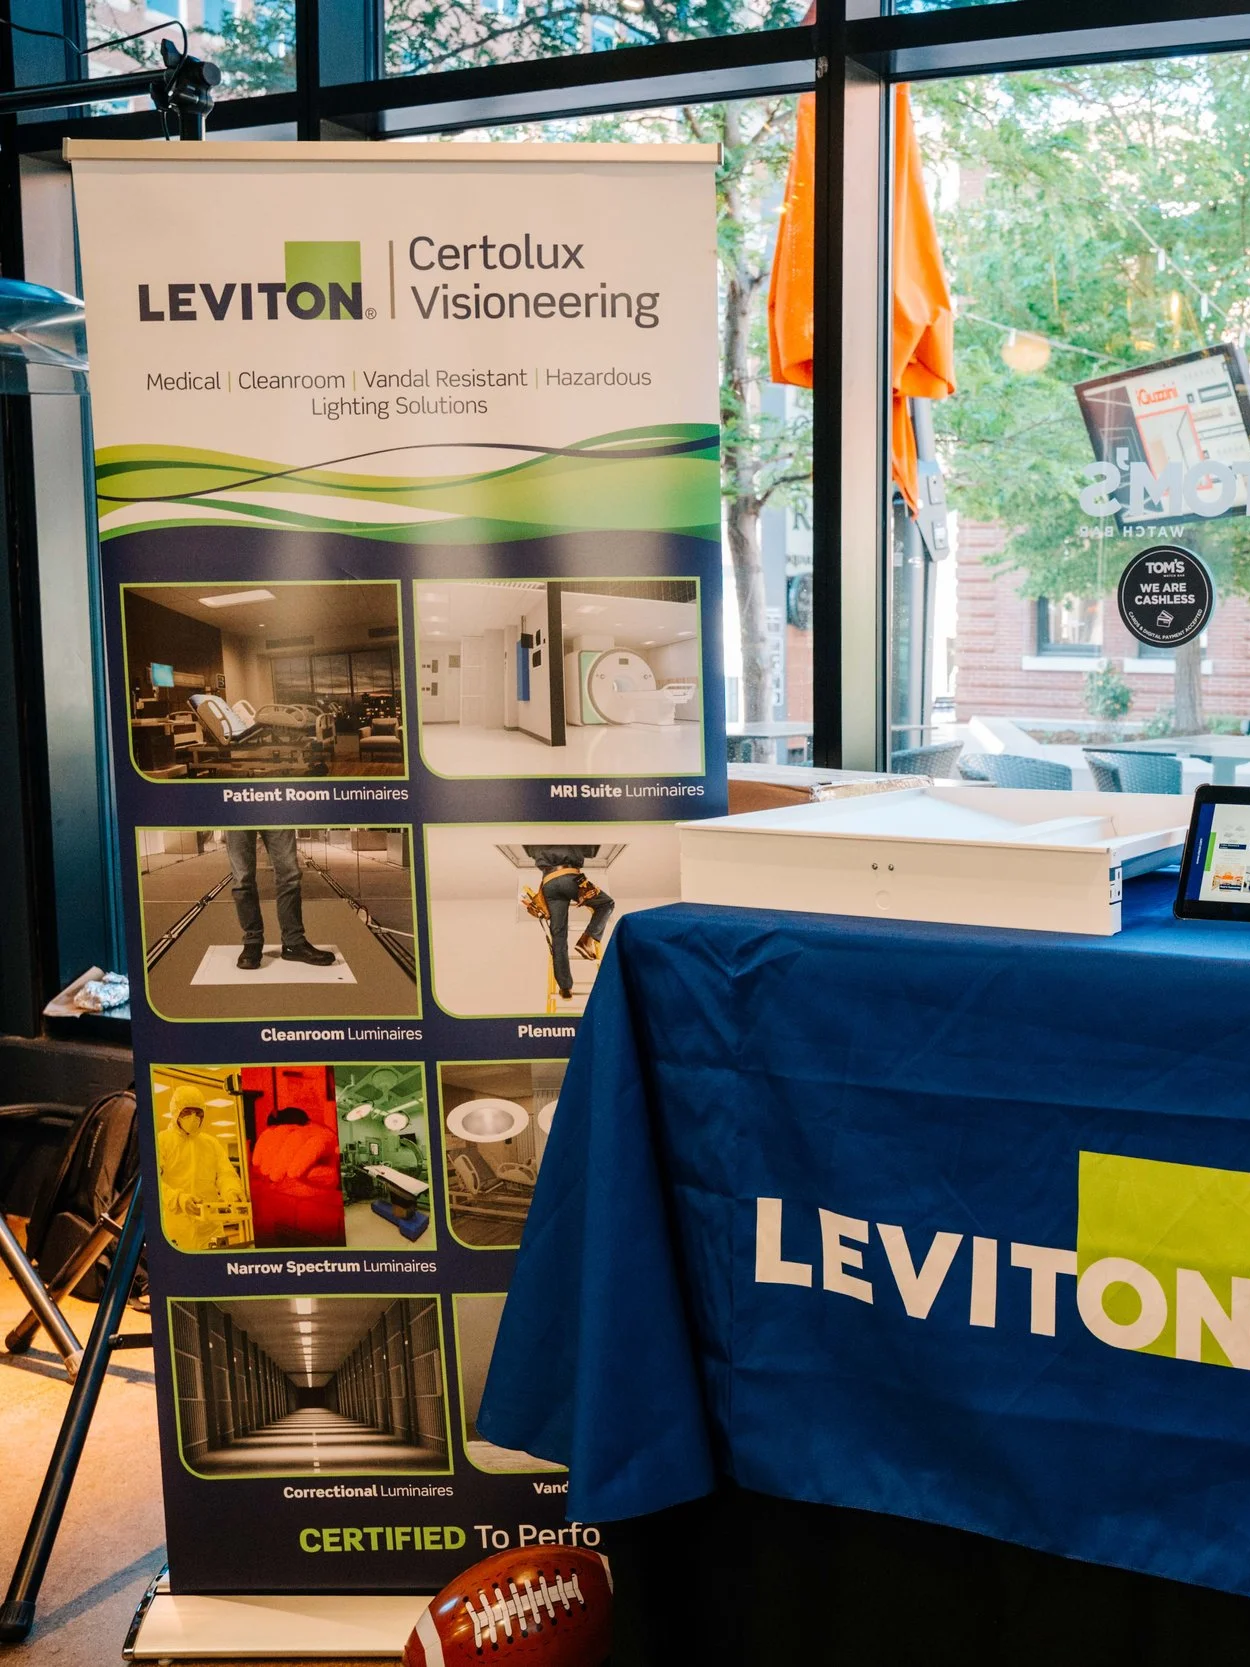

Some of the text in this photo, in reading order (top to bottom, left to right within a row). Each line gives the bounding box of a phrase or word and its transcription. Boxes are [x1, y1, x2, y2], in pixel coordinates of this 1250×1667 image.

[408, 233, 585, 271] Certolux
[410, 282, 660, 329] Visioneering
[146, 367, 652, 391] Medical Cleanroom Vandal Resistant Hazardous
[1136, 382, 1179, 407] iGuzzini
[311, 394, 488, 421] Lighting Solutions
[1145, 558, 1185, 574] TOM'S
[1140, 583, 1187, 593] WE ARE
[1134, 594, 1196, 605] CASHLESS
[1128, 611, 1141, 628] CARDS
[1143, 628, 1162, 640] DIGITAL
[1162, 630, 1185, 640] PAYMENT
[1185, 608, 1203, 633] ACCEPTED
[223, 786, 409, 803] Patient Room Luminaires
[550, 783, 705, 798] MRI Suite Luminaires
[261, 1025, 423, 1042] Cleanroom Luminaires
[518, 1024, 576, 1038] Plenum
[227, 1258, 437, 1276] Narrow Spectrum Luminaires
[283, 1483, 454, 1499] Correctional Luminaires
[300, 1525, 466, 1553] CERTIFIED
[474, 1524, 510, 1549] To
